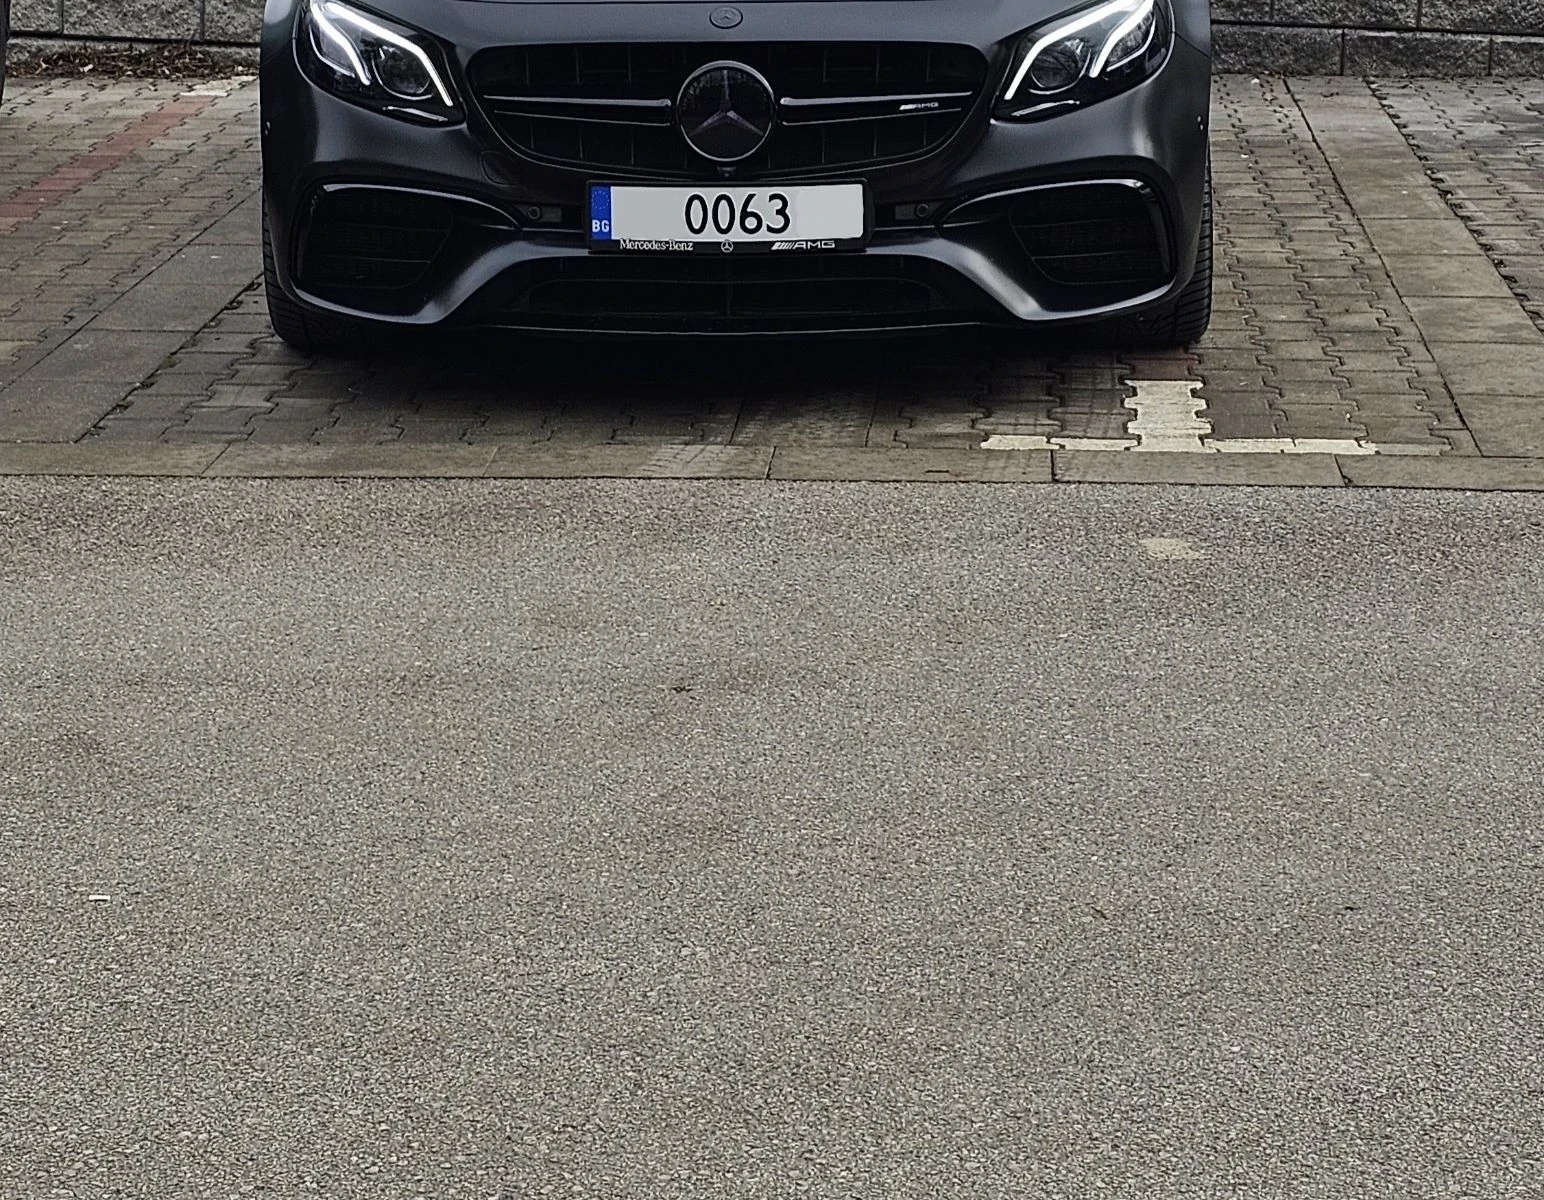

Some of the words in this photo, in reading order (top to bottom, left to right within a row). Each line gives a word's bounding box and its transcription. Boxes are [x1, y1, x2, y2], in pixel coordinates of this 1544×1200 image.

[684, 192, 791, 235] 0063
[592, 220, 610, 233] BG
[619, 238, 694, 251] Mercedes-Benz
[794, 240, 836, 249] AMG
